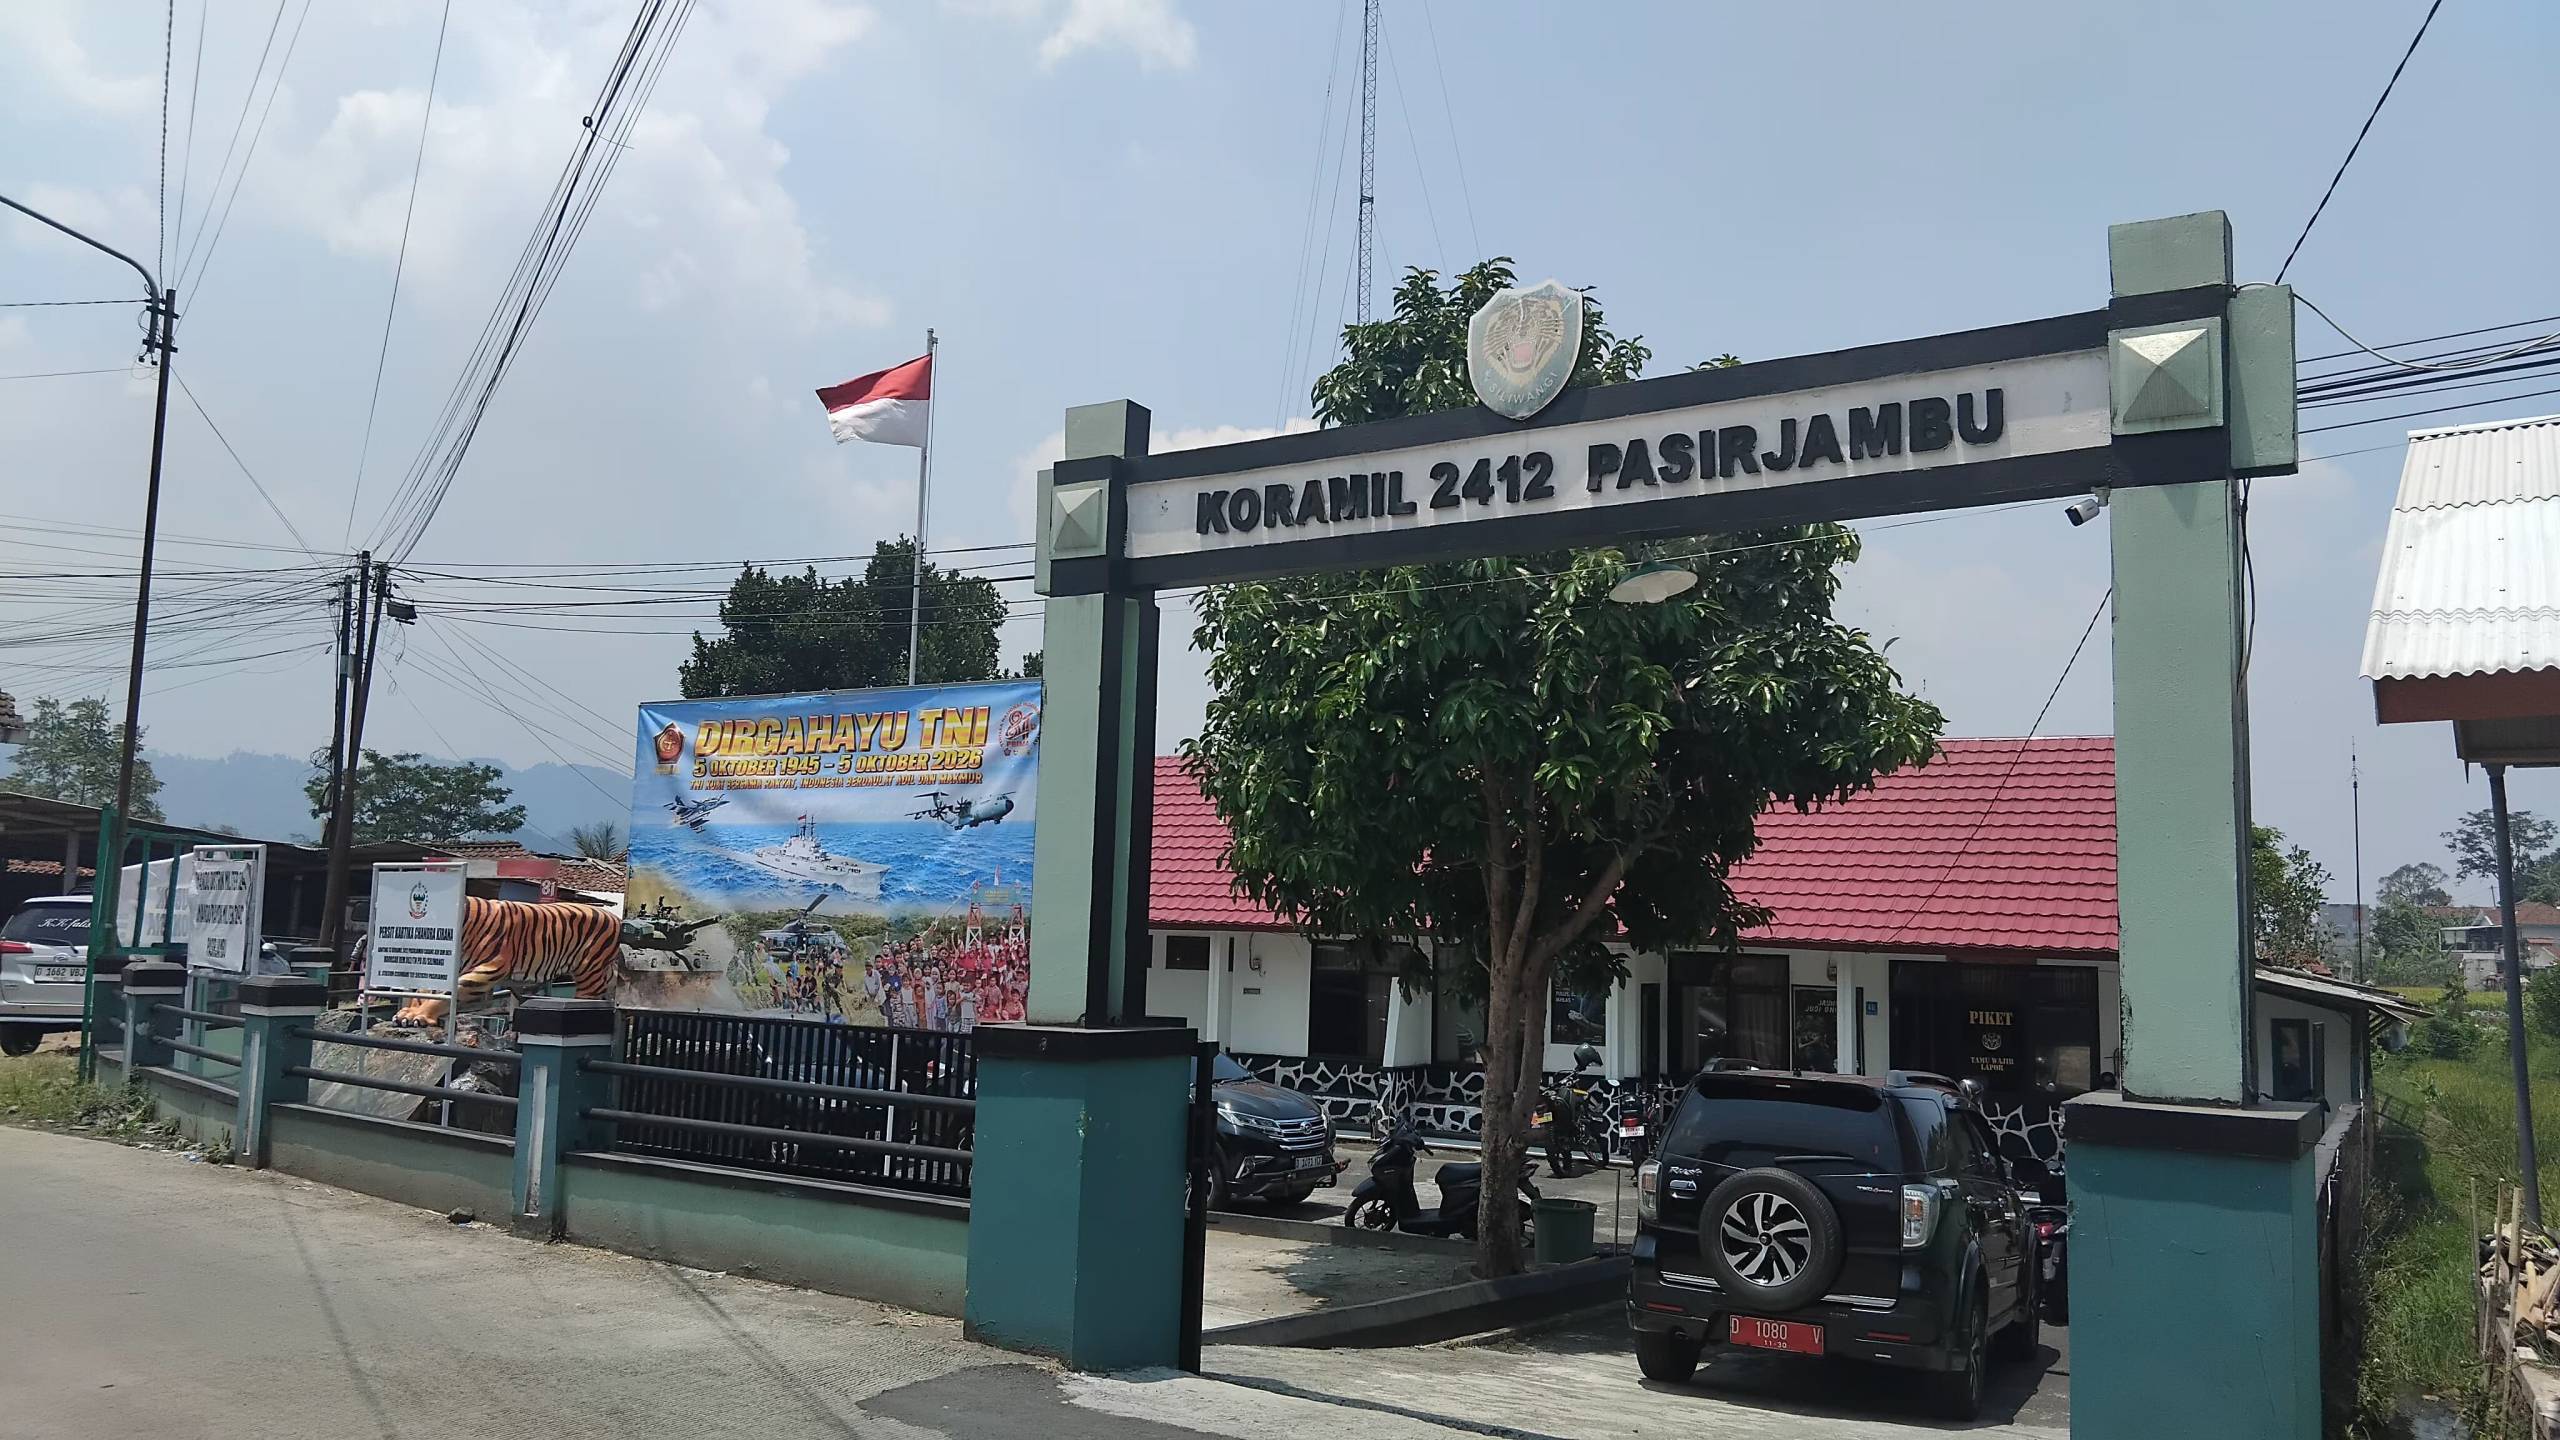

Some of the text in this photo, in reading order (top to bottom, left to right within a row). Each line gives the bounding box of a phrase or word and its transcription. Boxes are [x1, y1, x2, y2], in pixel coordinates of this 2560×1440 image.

[1489, 370, 1559, 403] SILIWANGI
[1196, 388, 2005, 536] KORAMIL 2412 PASIRJAMBU
[694, 706, 991, 757] DIRGAHAYU TNI
[693, 757, 707, 777] 5
[709, 759, 779, 777] OKTOBER
[779, 756, 821, 776] 1945
[837, 753, 853, 774] 5
[855, 752, 930, 773] OKTOBER
[930, 749, 984, 771] 2026
[690, 780, 704, 791] TNI
[705, 779, 725, 790] KUAT
[726, 778, 763, 790] BERSAMA
[799, 776, 844, 788] INDONESIA
[845, 774, 894, 788] BERDAULAT
[895, 775, 915, 786] ADIL
[917, 774, 937, 786] DAN
[938, 772, 984, 786] MAKMUR
[1969, 1010, 2014, 1026] PIKET
[1970, 1056, 1991, 1064] TAMU
[1731, 1317, 1821, 1345] D 1080 V
